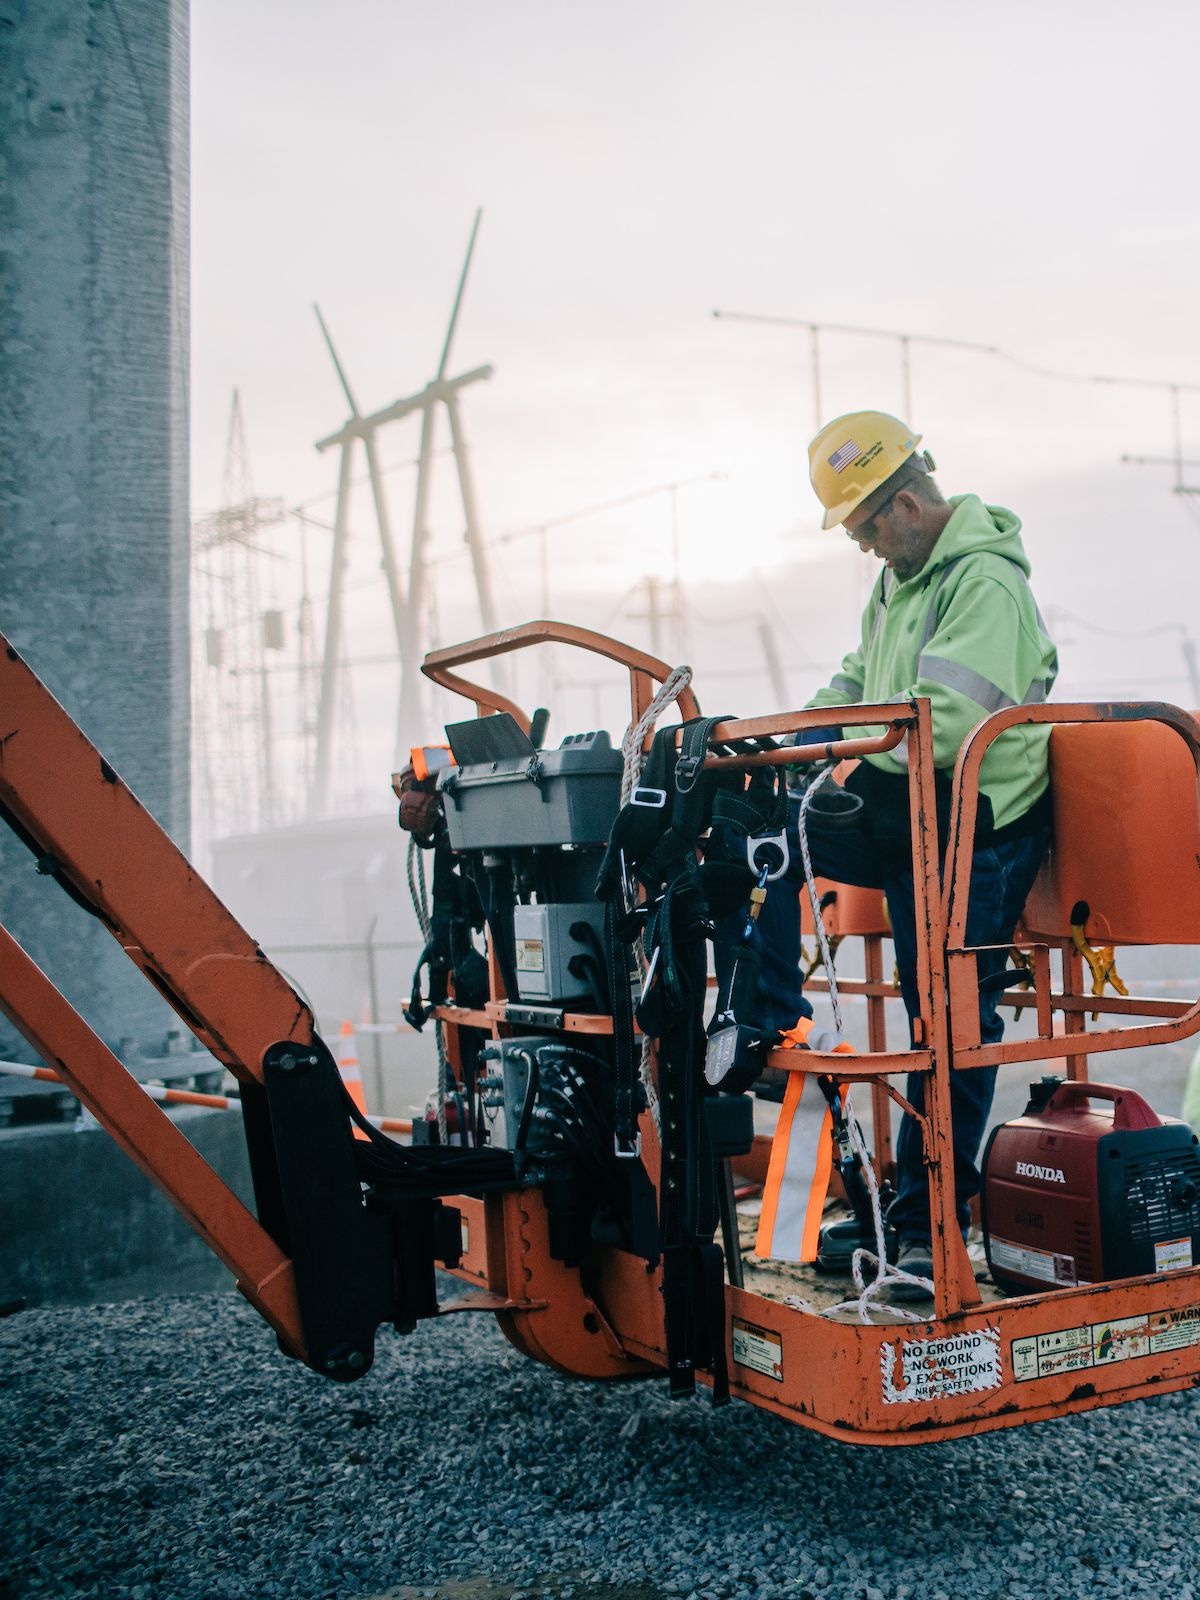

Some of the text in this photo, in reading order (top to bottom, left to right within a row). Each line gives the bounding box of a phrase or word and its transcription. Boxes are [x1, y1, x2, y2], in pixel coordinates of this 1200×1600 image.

[1015, 1161, 1066, 1183] HONDA
[902, 1337, 981, 1358] NO GROUND
[936, 1351, 974, 1368] WORK
[942, 1379, 974, 1391] SAFETY
